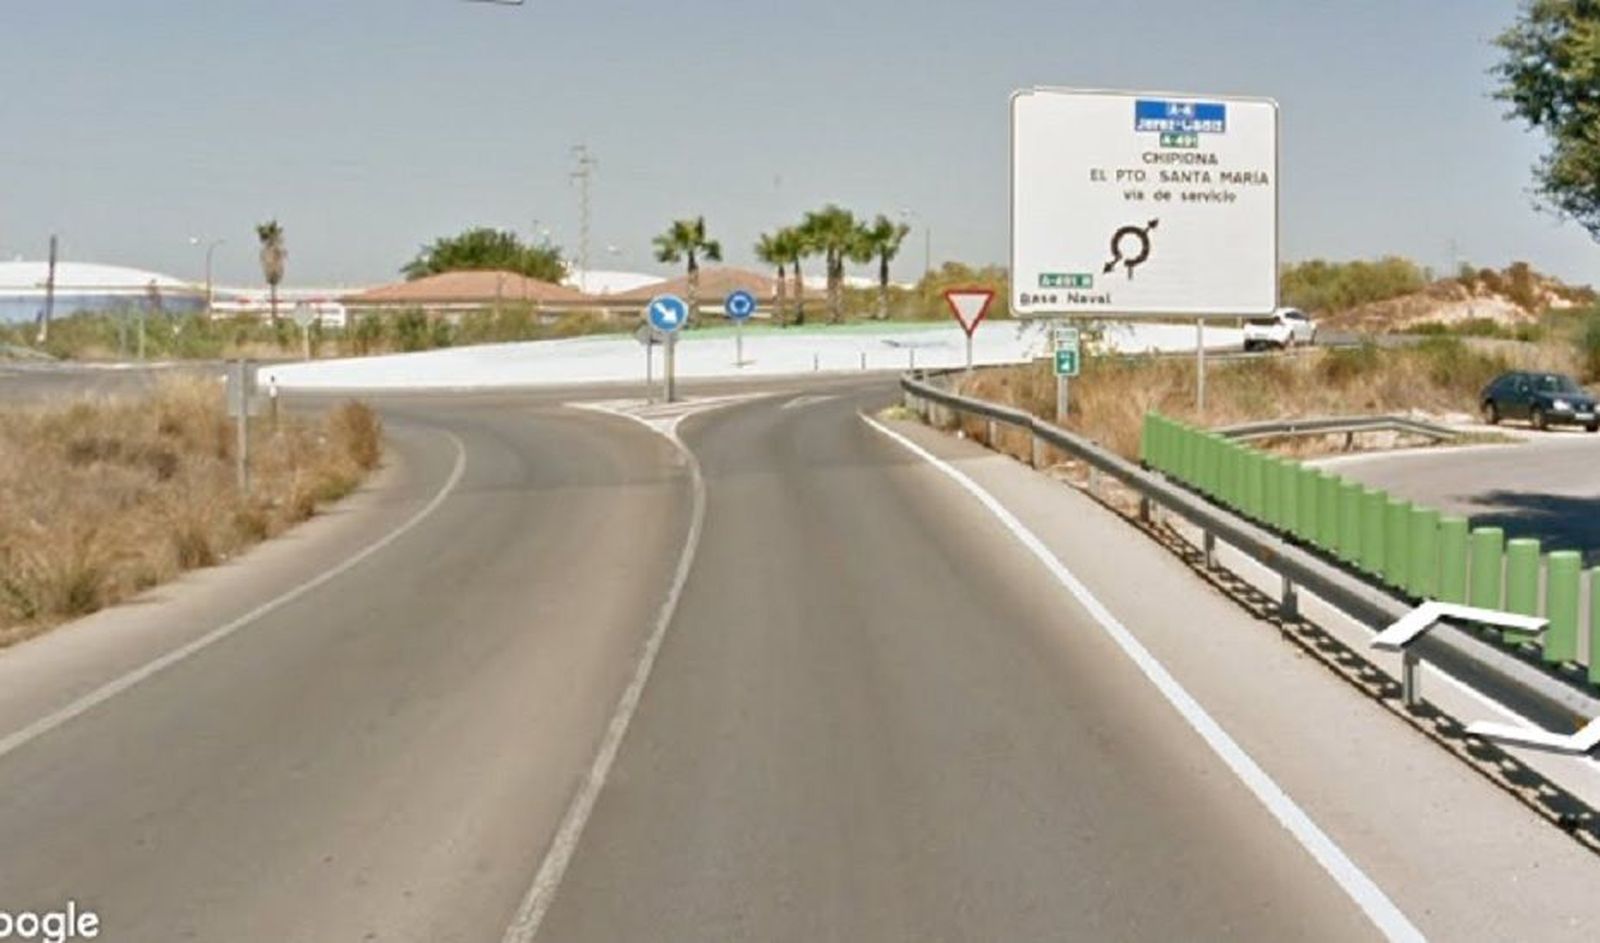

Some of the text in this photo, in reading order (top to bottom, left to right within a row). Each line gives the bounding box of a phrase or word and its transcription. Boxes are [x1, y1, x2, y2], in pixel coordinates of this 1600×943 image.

[1163, 133, 1197, 144] A-491
[1142, 151, 1219, 165] CHIPIONA
[1090, 169, 1107, 182] EL
[1159, 170, 1211, 183] SANTA
[1153, 189, 1172, 201] de
[1181, 189, 1237, 202] servicio
[1020, 291, 1110, 306] Base Naval
